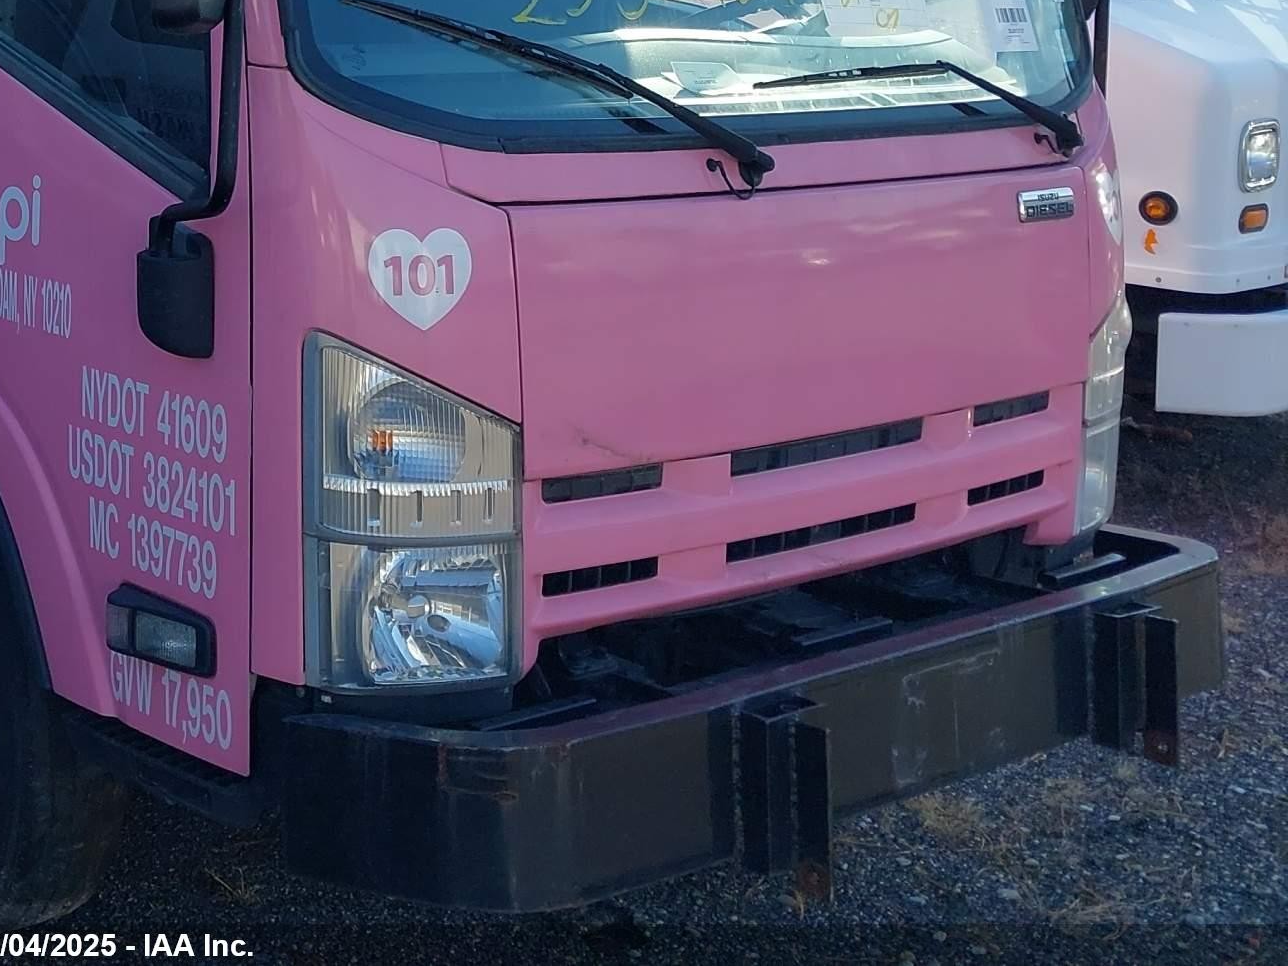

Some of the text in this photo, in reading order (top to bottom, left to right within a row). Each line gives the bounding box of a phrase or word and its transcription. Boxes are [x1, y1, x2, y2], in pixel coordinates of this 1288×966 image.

[1026, 201, 1073, 218] DIESEL
[1037, 192, 1059, 202] ISUZU
[23, 273, 38, 328] NY
[41, 278, 72, 339] 10210
[383, 254, 455, 297] 101
[80, 365, 229, 464] NYDOT 41609
[67, 424, 239, 538] USDOT 3824101
[88, 495, 218, 601] MC 1397739
[110, 650, 233, 752] GVW 17,950
